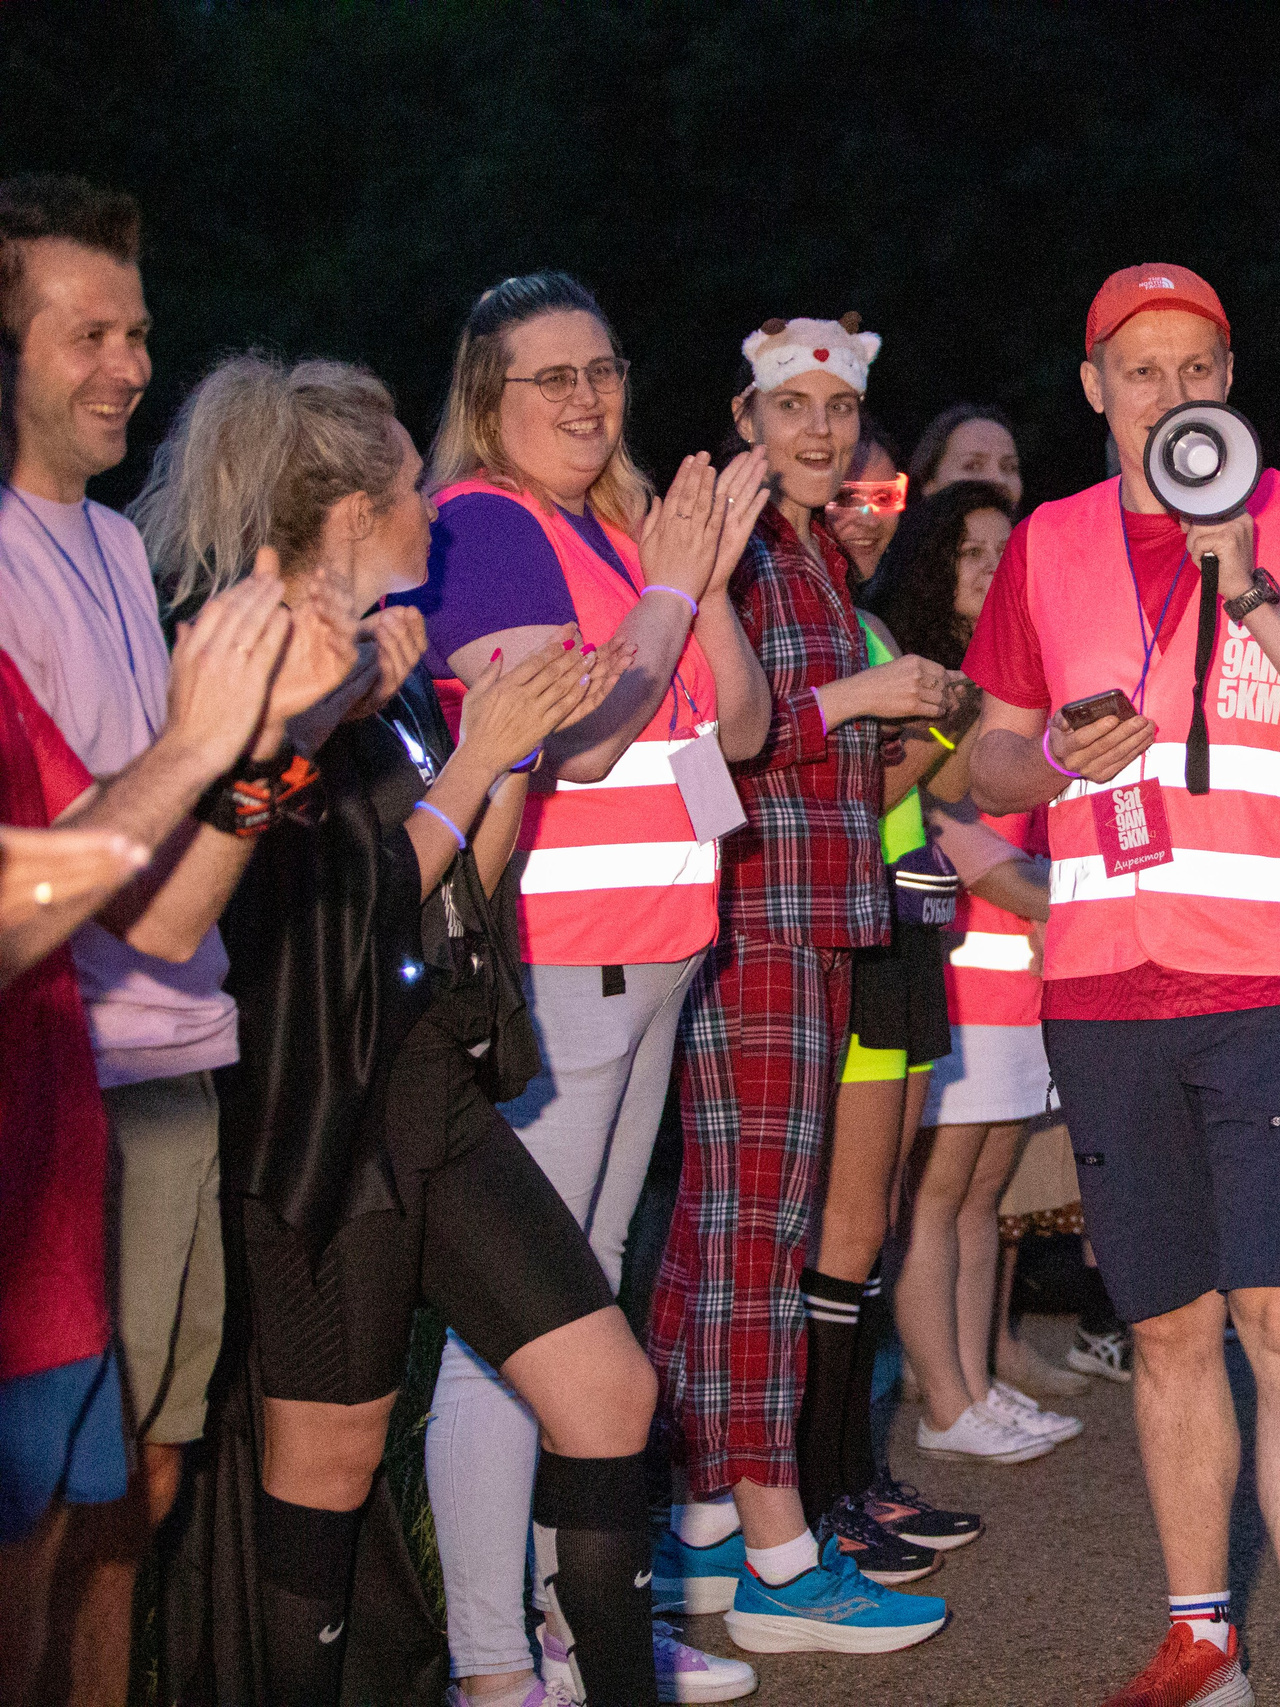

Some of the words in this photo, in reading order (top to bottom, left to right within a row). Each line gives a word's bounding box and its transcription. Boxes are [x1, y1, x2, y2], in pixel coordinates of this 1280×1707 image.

[1112, 786, 1144, 814] Sat
[1115, 808, 1147, 832] 9AM
[1118, 826, 1150, 851] 5KM
[1113, 850, 1166, 873] Директор
